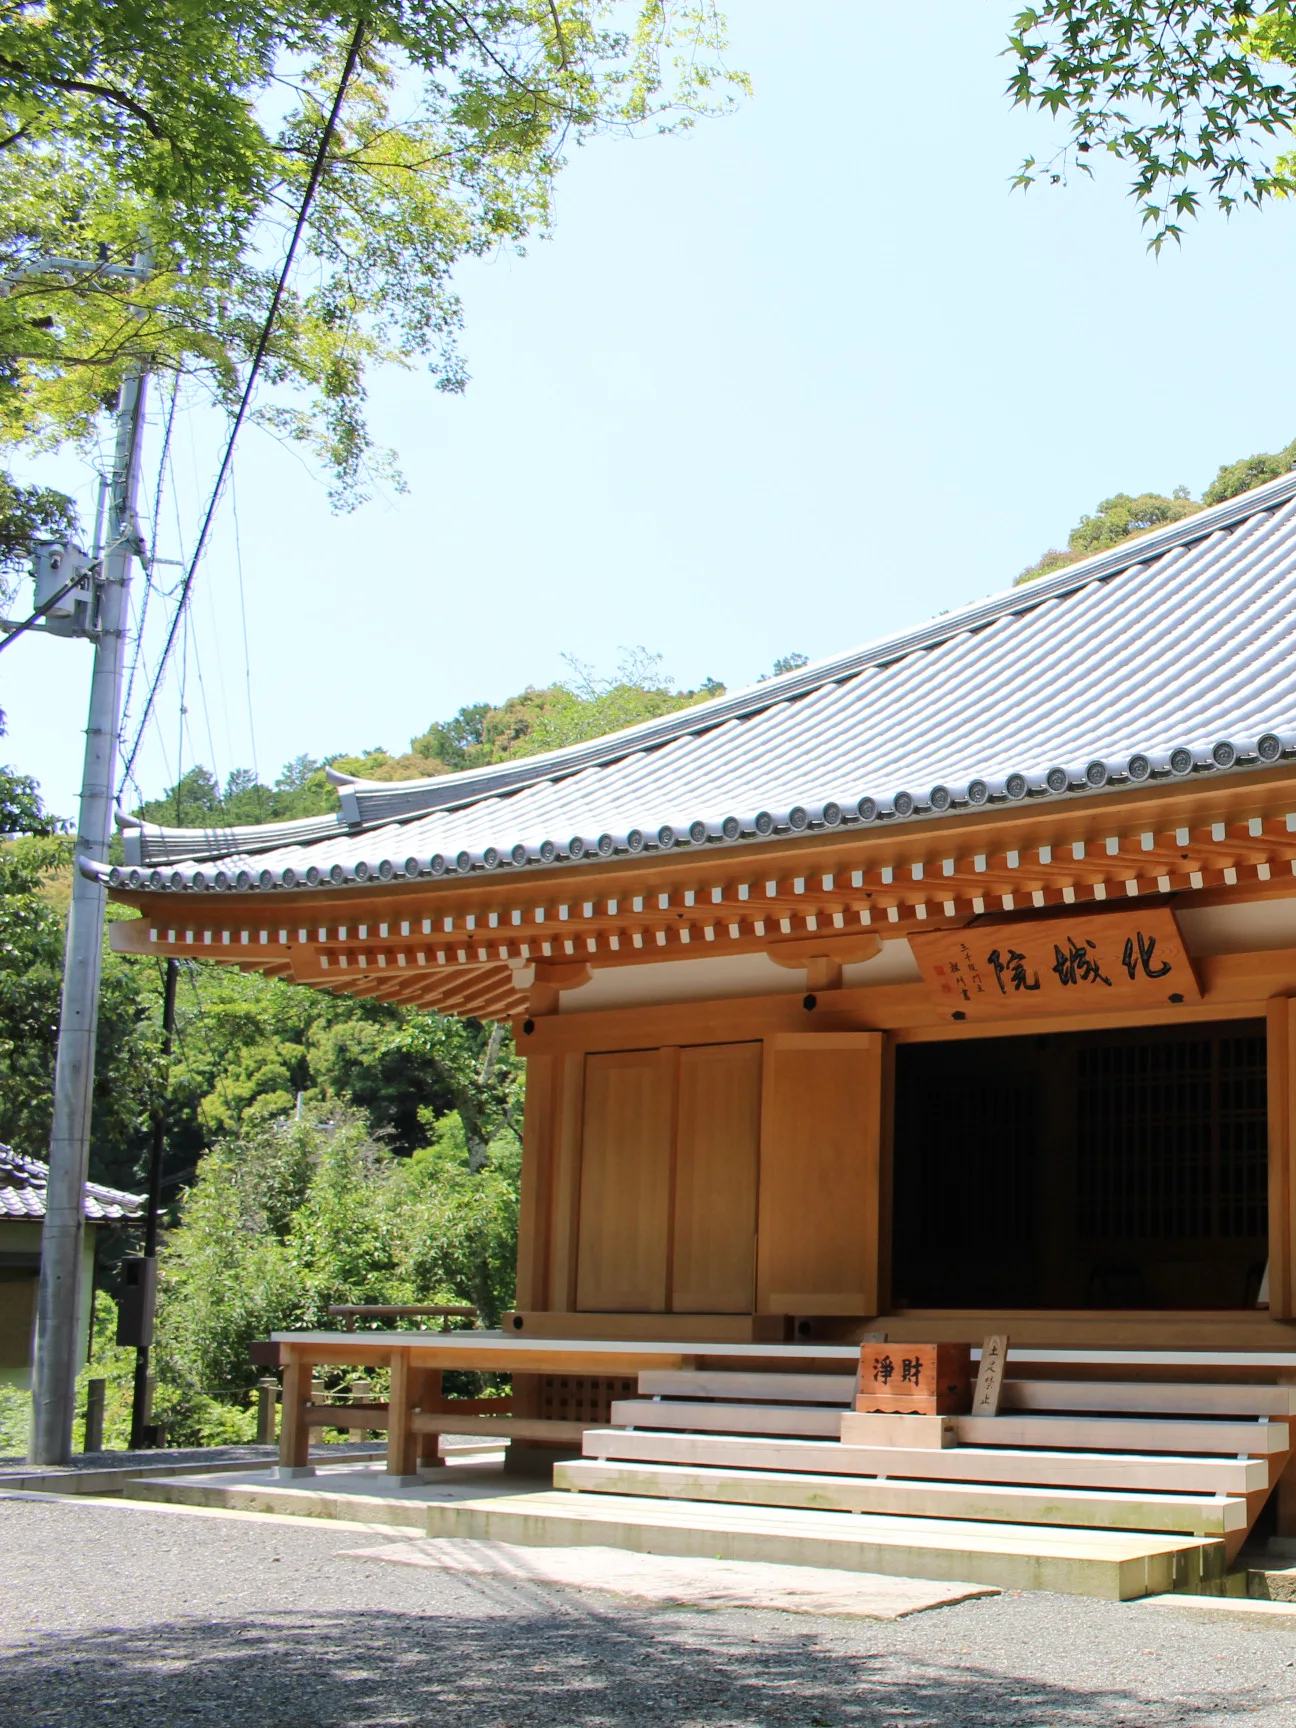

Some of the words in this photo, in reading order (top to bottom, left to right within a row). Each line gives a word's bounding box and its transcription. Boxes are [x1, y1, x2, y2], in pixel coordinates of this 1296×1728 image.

[987, 931, 1172, 995] 化城院
[980, 1345, 999, 1405] 土足禁止
